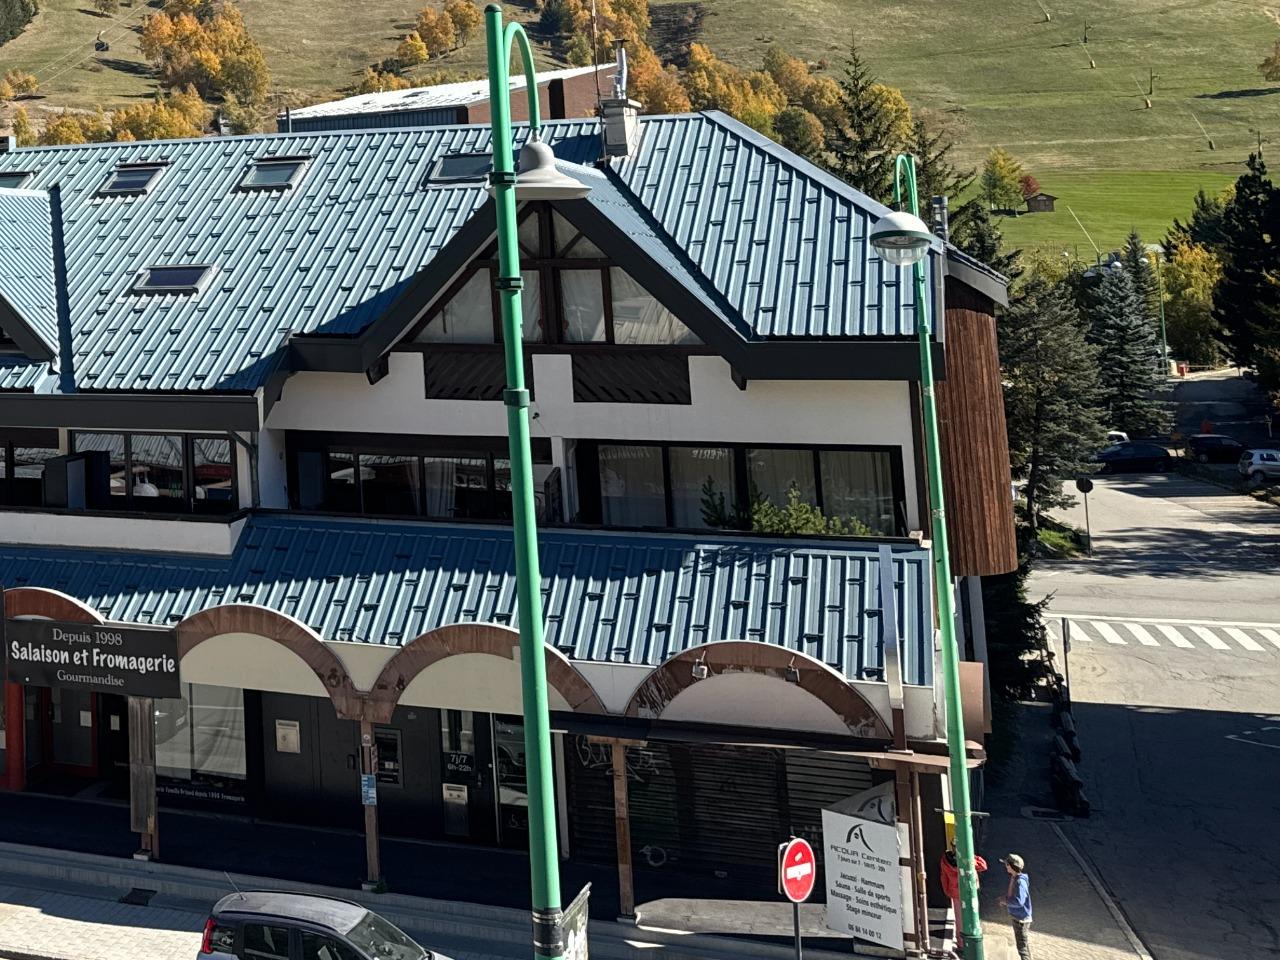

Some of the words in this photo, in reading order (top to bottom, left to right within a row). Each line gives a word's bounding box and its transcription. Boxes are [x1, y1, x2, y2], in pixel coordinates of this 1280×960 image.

[52, 628, 91, 645] Depuis
[95, 631, 123, 646] 1998
[11, 640, 70, 665] Salaison
[73, 648, 89, 666] et
[92, 648, 176, 674] Fromagerie
[56, 669, 125, 687] Gourmandise
[835, 880, 851, 891] Sauna
[854, 885, 867, 896] Salle
[867, 888, 874, 897] de
[875, 892, 891, 902] sports
[860, 877, 885, 890] Hammam
[830, 889, 852, 902] Massage
[855, 893, 870, 907] Soins
[846, 903, 860, 915] Stage
